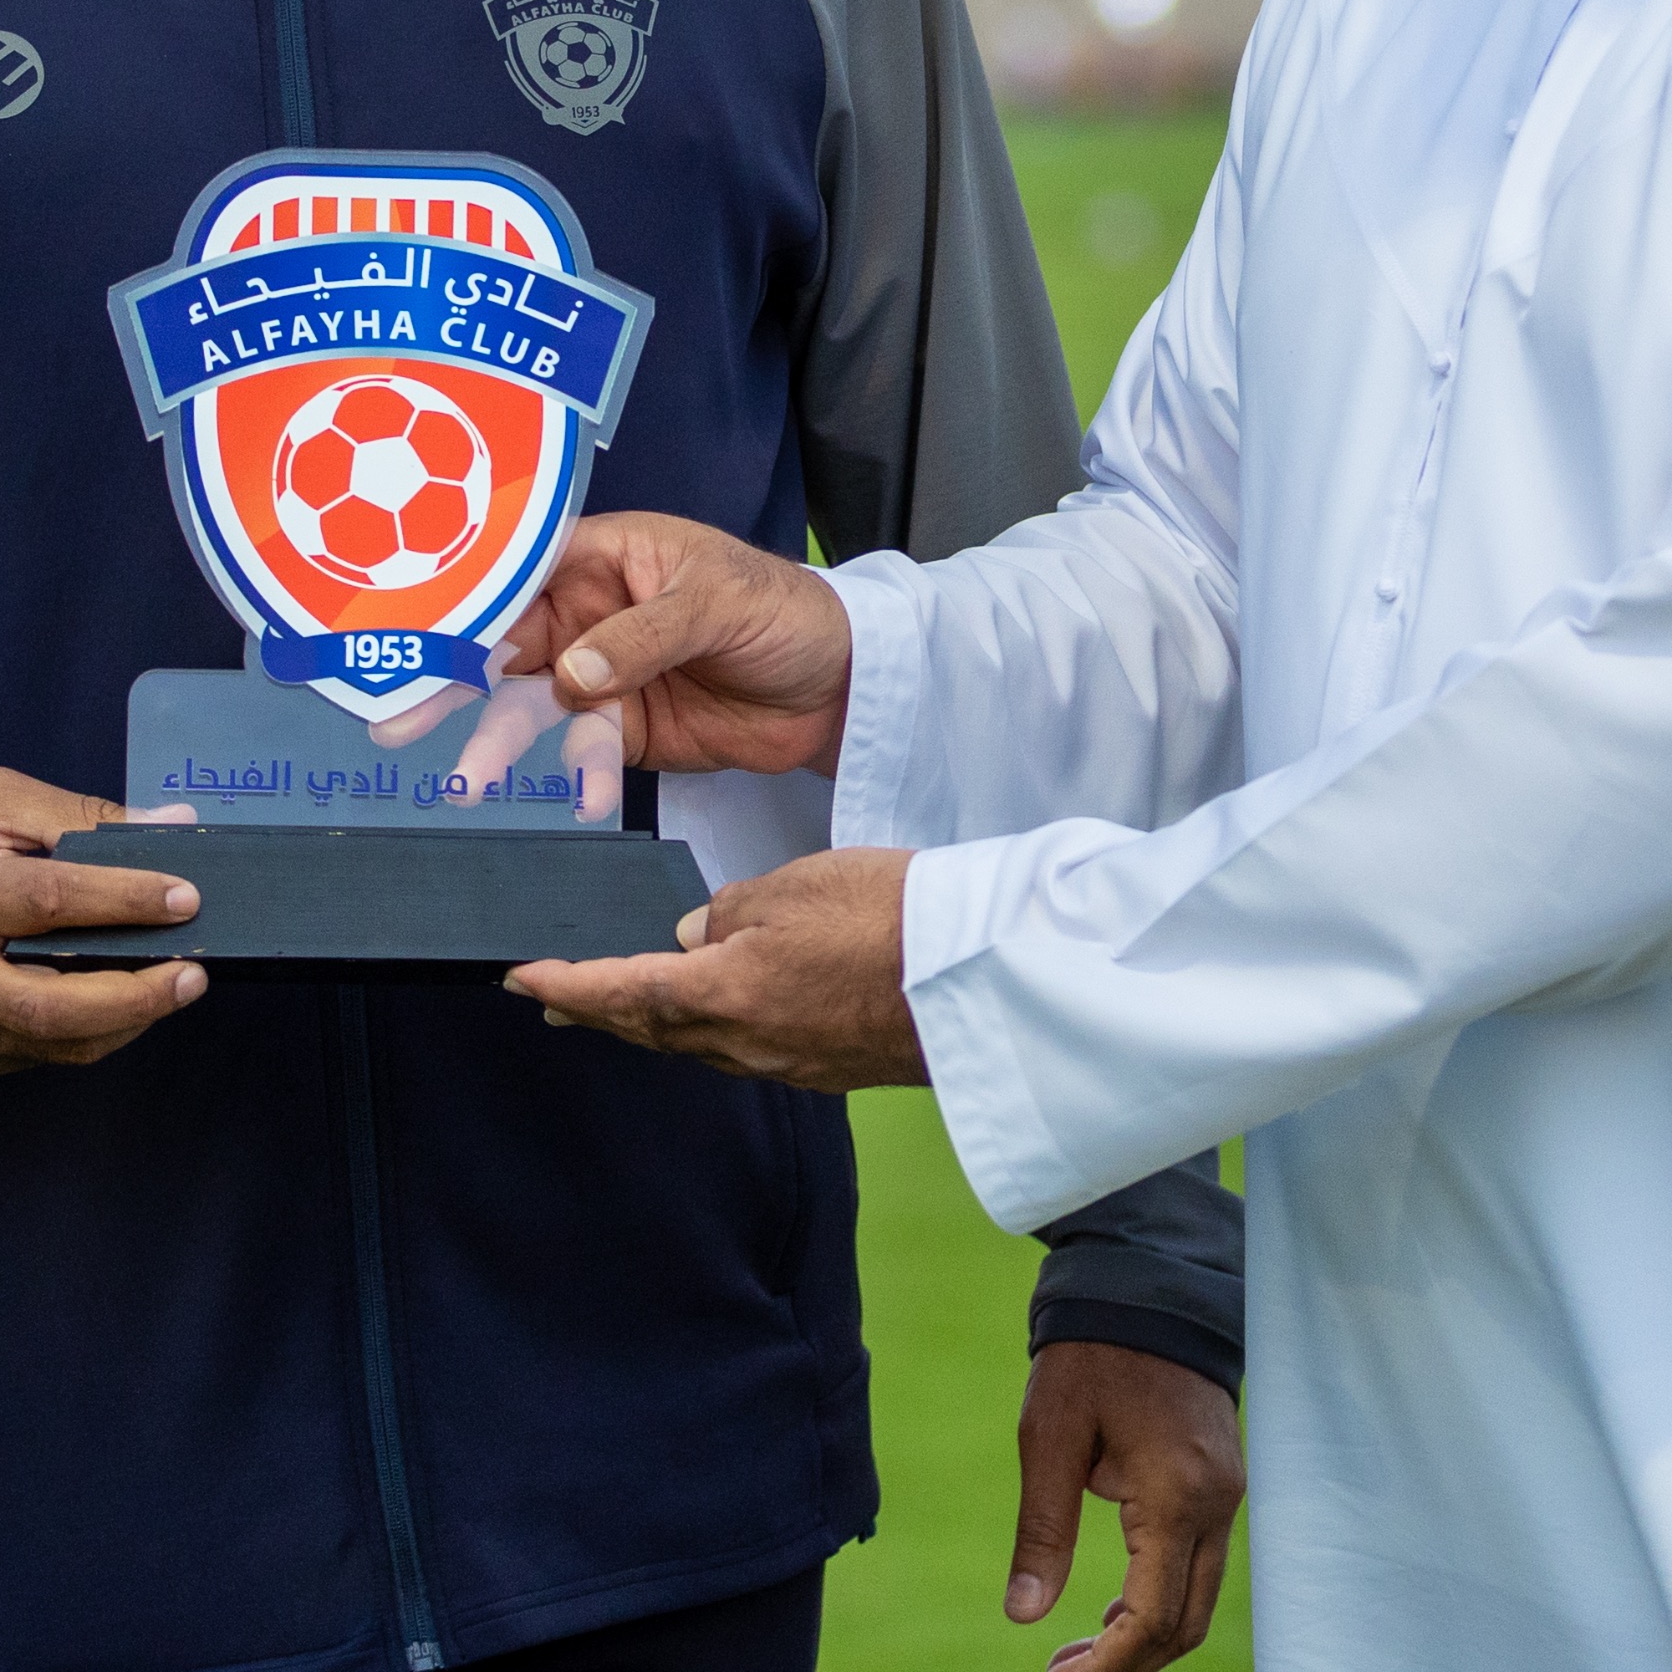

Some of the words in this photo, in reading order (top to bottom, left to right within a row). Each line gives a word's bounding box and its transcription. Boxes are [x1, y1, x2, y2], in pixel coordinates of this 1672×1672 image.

[510, 2, 585, 27] ALFAYHA
[591, 3, 635, 24] CLUB
[571, 105, 600, 119] 1953
[200, 309, 417, 373] ALFAYHA
[439, 316, 561, 380] CLUB
[343, 634, 424, 670] 1953
[161, 758, 292, 802] الفيحاء
[307, 762, 399, 804] نادي
[413, 773, 469, 805] من
[482, 766, 585, 812] إهداء
